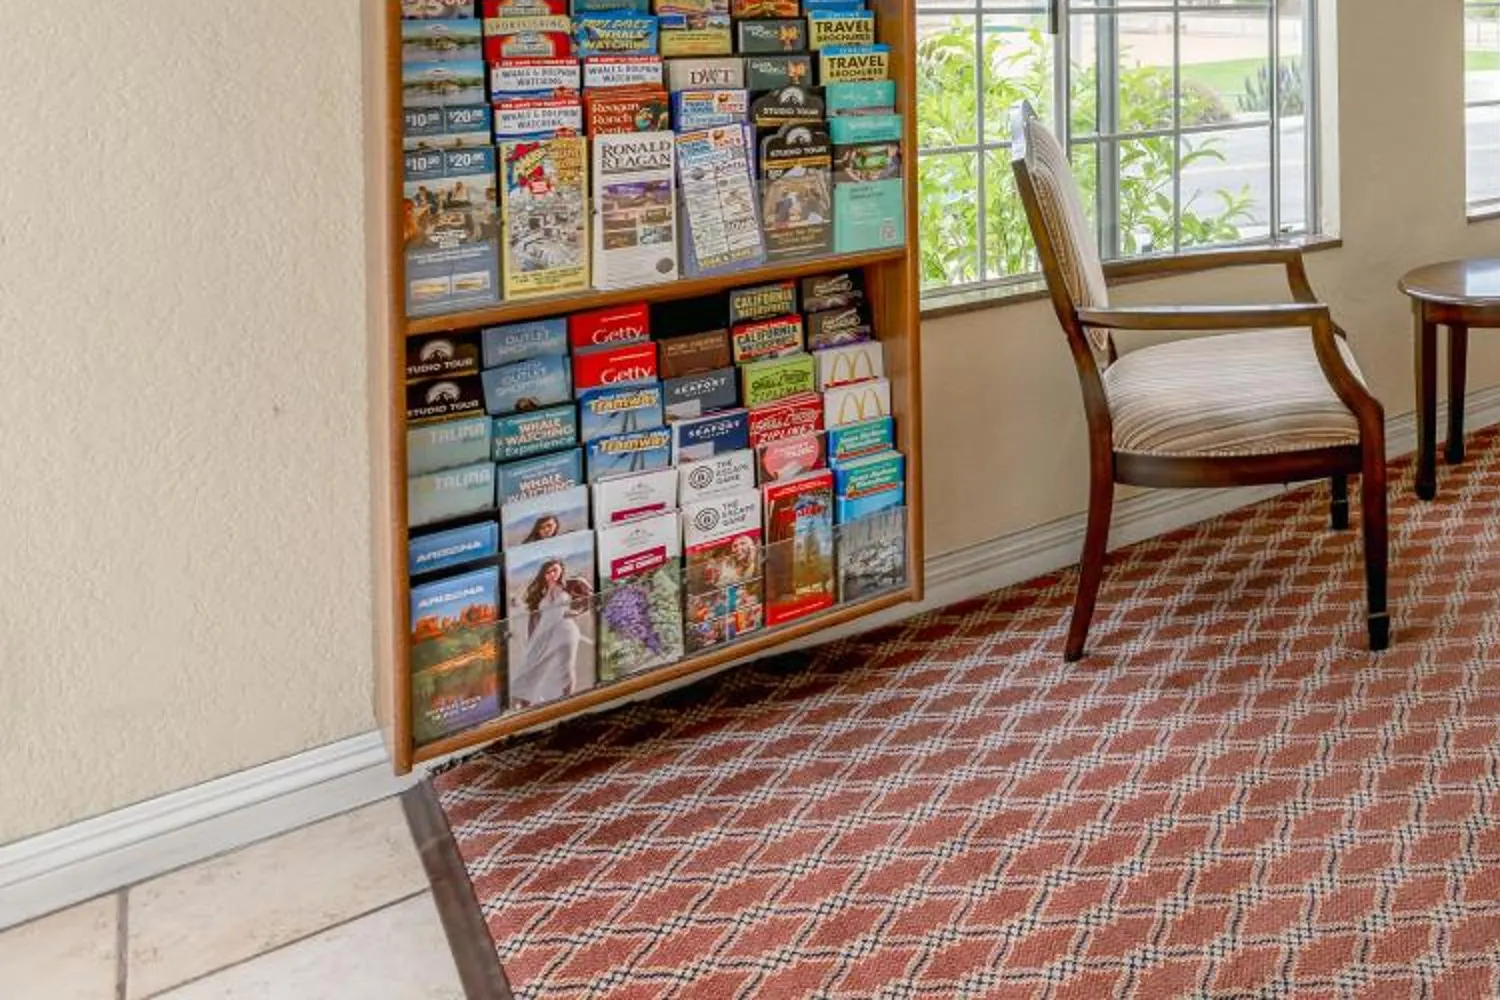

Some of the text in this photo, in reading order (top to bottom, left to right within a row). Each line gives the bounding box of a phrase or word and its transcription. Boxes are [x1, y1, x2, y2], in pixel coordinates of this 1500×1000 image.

[815, 19, 873, 33] TRAVEL
[816, 32, 872, 42] BROCHURES
[828, 55, 885, 70] TRAVEL
[828, 67, 884, 78] BROCHURES
[601, 138, 672, 156] RONALD
[601, 152, 672, 170] REAGAN
[591, 325, 645, 345] Getty
[407, 357, 473, 375] TUDIO TOUR
[600, 365, 653, 386] Getty
[450, 399, 479, 413] TOUR
[518, 417, 562, 433] WHALE
[505, 427, 574, 446] WATCHING
[505, 436, 575, 456] Experience
